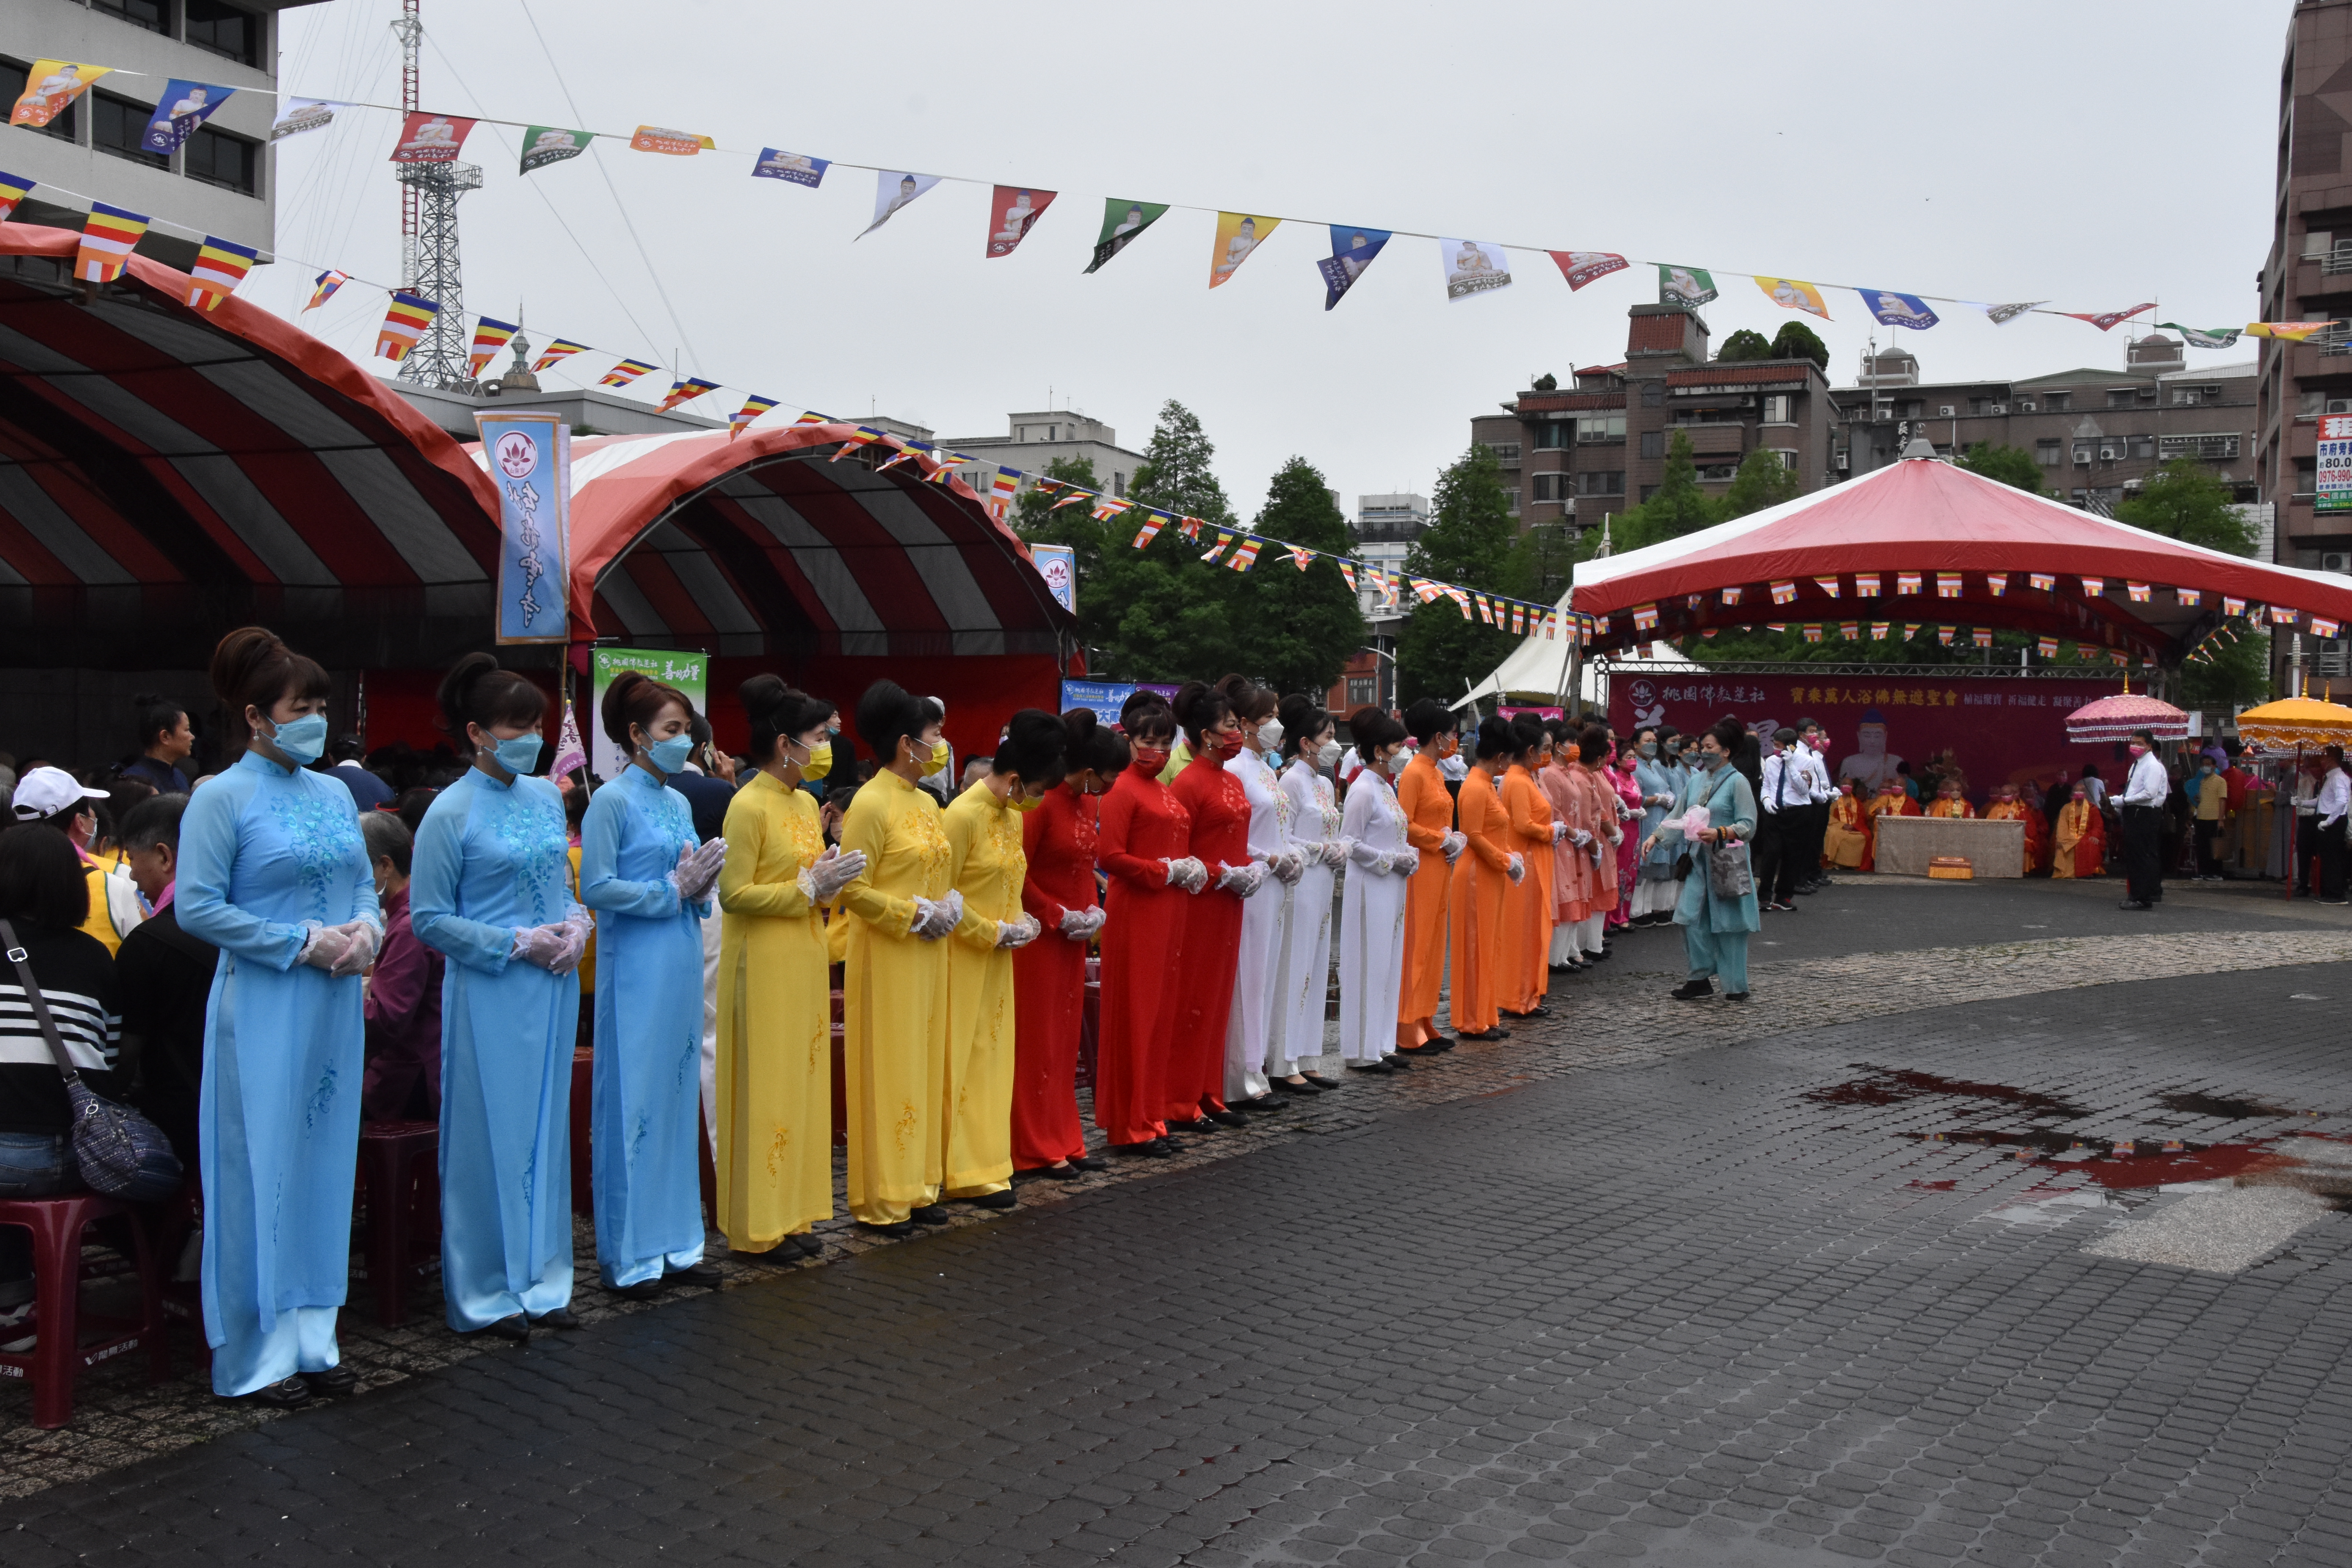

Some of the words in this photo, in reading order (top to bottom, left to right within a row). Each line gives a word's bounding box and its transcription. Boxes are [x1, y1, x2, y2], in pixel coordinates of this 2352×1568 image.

[1662, 684, 1766, 708] 桃園佛教蓮社
[0, 1365, 24, 1377] 活動
